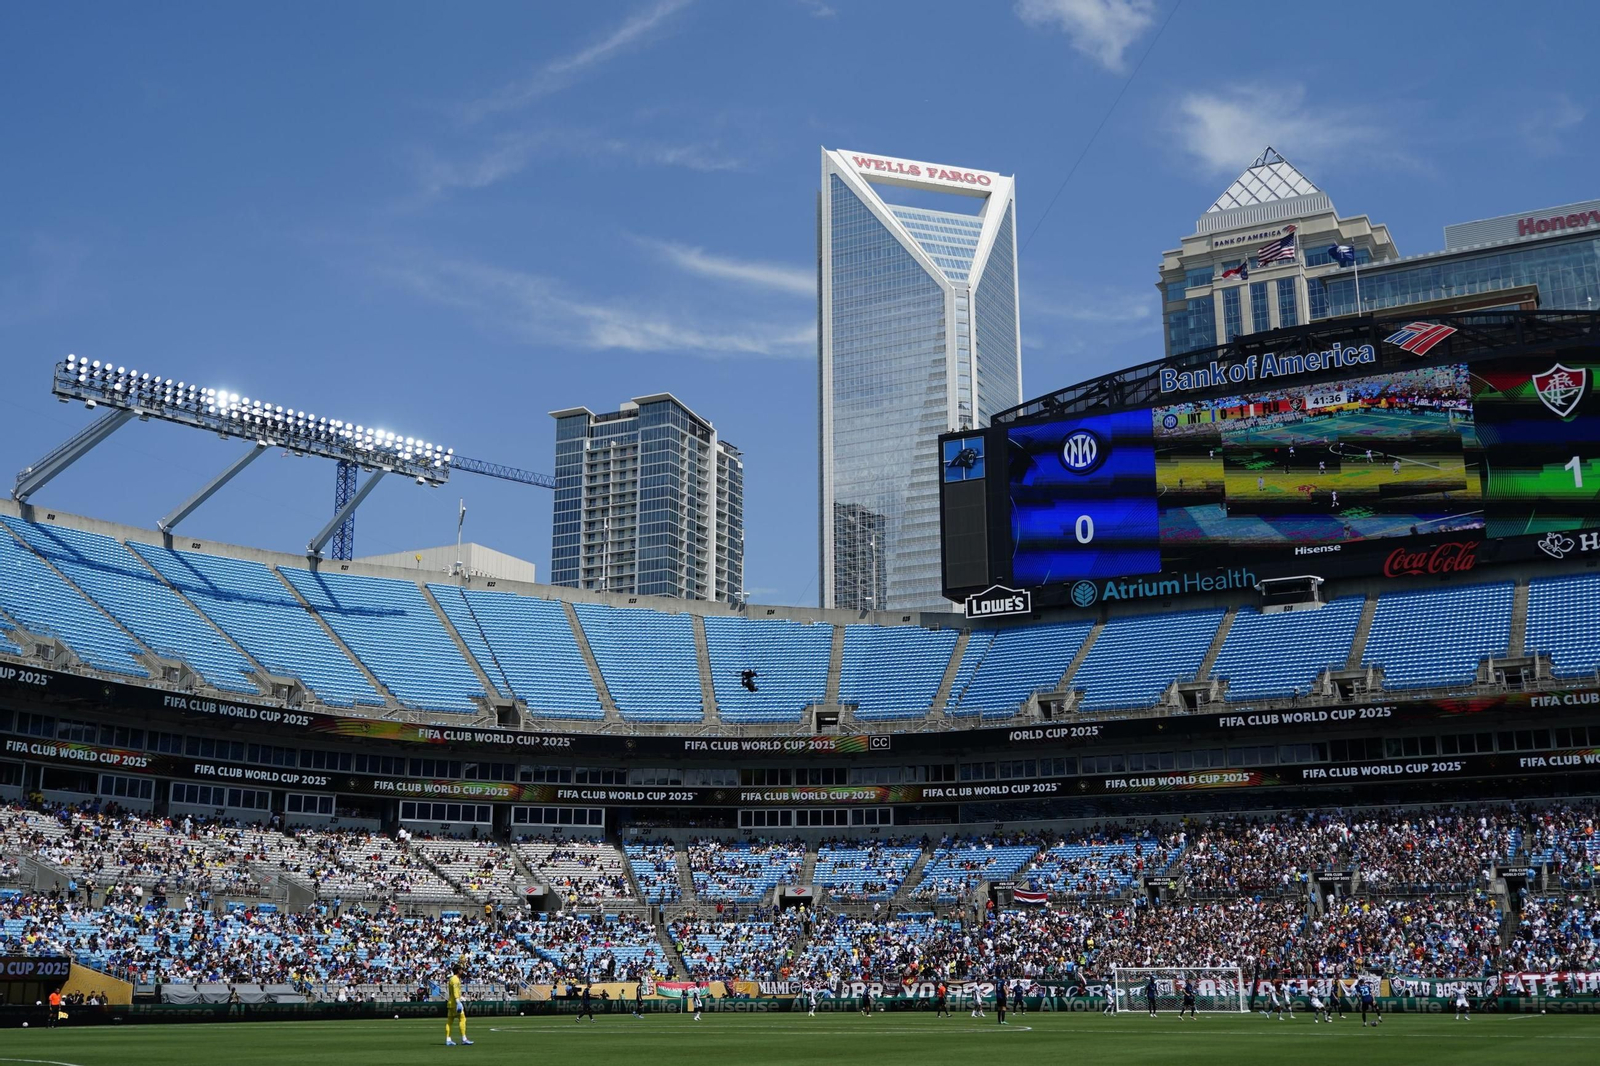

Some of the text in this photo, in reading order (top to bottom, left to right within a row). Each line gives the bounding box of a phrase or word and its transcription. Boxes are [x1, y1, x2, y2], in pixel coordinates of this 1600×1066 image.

[852, 156, 992, 187] WELLS FARGO
[1214, 239, 1235, 248] BANK
[1248, 229, 1281, 241] AMERICA
[1160, 342, 1376, 393] Bank of America
[1313, 394, 1342, 405] 41:36
[1188, 413, 1202, 425] INT
[1564, 456, 1583, 488] 1
[1075, 515, 1094, 544] 0
[1295, 544, 1341, 556] Hisense
[1102, 568, 1256, 601] Atrium Health
[972, 594, 1025, 616] LOWE'S
[0, 666, 16, 679] UP
[1530, 693, 1600, 708] FIFA CLUB
[163, 695, 187, 709] FIFA
[189, 699, 217, 714] CLUB
[219, 704, 257, 719] WORLD
[259, 710, 281, 722] CUP
[1219, 716, 1245, 727] FIFA
[1247, 714, 1279, 726] CLUB
[1282, 710, 1328, 723] WORLD
[1330, 709, 1356, 720] CUP
[418, 728, 441, 740] FIFA
[443, 730, 472, 741] CLUB
[474, 732, 514, 744] WORLD
[516, 735, 540, 746] CUP
[1045, 727, 1068, 739] CUP
[684, 741, 708, 751] FIFA
[710, 741, 739, 751] CLUB
[741, 741, 782, 751] WORLD
[784, 741, 806, 750] CUP
[872, 737, 888, 748] CC
[6, 740, 28, 753] FIFA
[31, 743, 57, 756] CLUB
[59, 747, 97, 761] WORLD
[99, 752, 121, 765] CUP
[1520, 755, 1581, 768] FIFA CLUB
[194, 763, 215, 775] FIFA
[217, 766, 243, 778] CLUB
[245, 769, 279, 782] WORLD
[281, 773, 299, 784] CUP
[1303, 768, 1327, 779] FIFA
[1329, 766, 1359, 778] CLUB
[1361, 765, 1403, 776] WORLD
[1405, 763, 1429, 774] CUP
[374, 780, 394, 791] FIFA
[396, 782, 422, 793] CLUB
[424, 784, 461, 795] WORLD
[462, 785, 483, 795] CUP
[1105, 779, 1127, 789] FIFA
[1129, 777, 1156, 788] CLUB
[1158, 775, 1197, 786] WORLD
[1199, 774, 1220, 784] CUP
[557, 789, 579, 799] FIFA
[580, 790, 606, 800] CLUB
[609, 791, 645, 801] WORLD
[647, 791, 667, 801] CUP
[741, 792, 762, 801] FIFA
[763, 792, 789, 801] CLUB
[791, 791, 828, 801] WORLD
[830, 791, 850, 800] CUP
[922, 788, 944, 798] FIFA
[946, 787, 972, 797] CLUB
[974, 785, 1009, 796] WORLD
[1011, 784, 1030, 795] CUP
[7, 962, 35, 976] CUP
[37, 962, 69, 976] 2025
[650, 999, 677, 1012] Life
[704, 998, 779, 1012] Hisense
[1040, 997, 1058, 1012] AI
[1061, 997, 1106, 1012] Your
[1402, 997, 1442, 1013] Life
